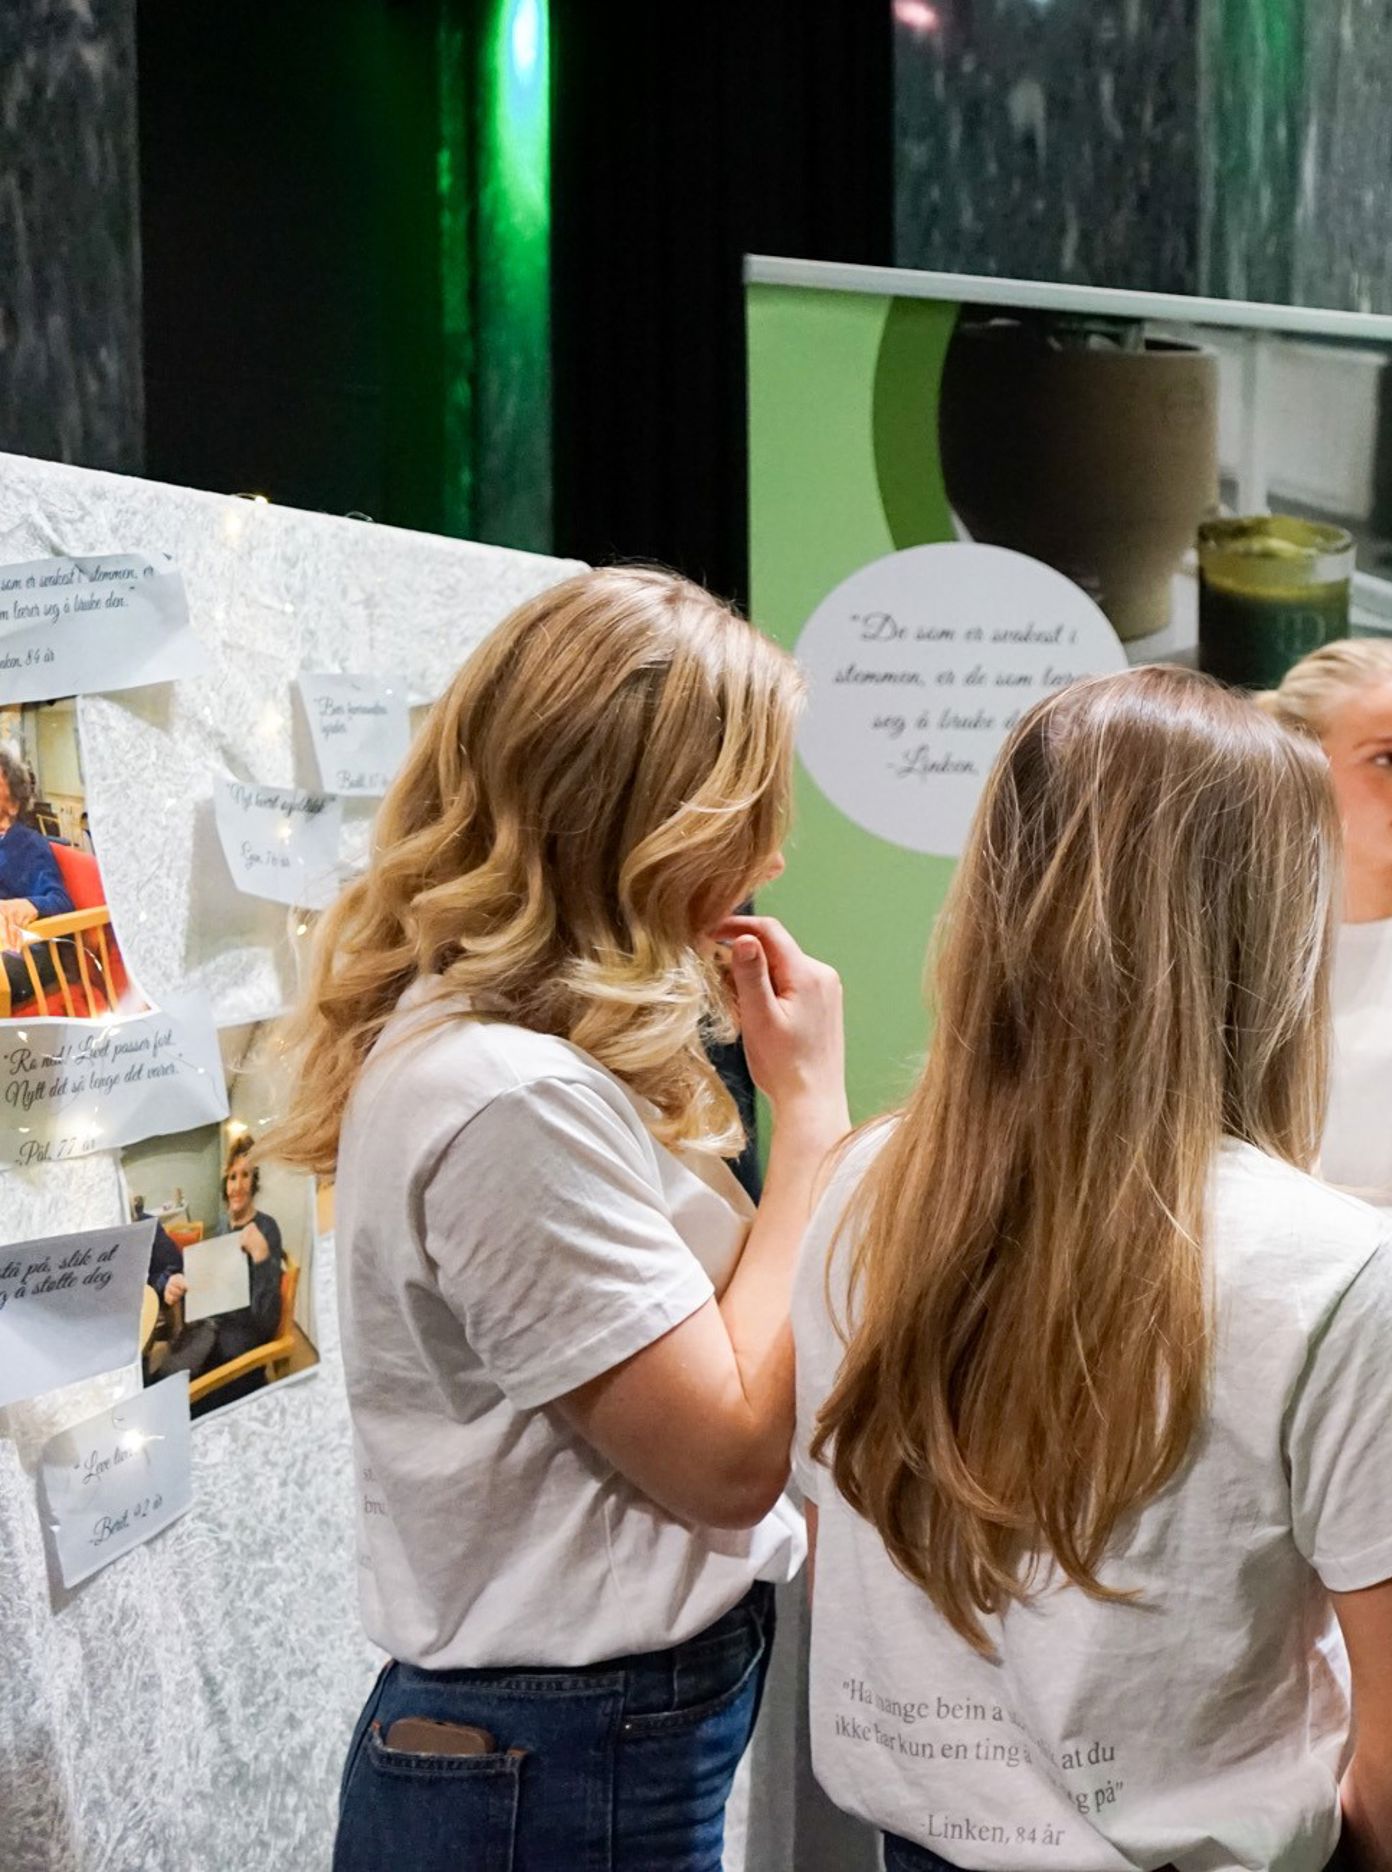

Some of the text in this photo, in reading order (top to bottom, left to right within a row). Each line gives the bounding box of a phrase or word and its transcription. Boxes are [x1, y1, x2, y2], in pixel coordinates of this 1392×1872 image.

[915, 625, 956, 643] som
[964, 626, 985, 642] er
[992, 620, 1066, 644] svakest
[832, 661, 926, 688] stemmen,
[935, 667, 956, 686] er
[964, 662, 988, 686] de
[996, 669, 1033, 687] som
[872, 714, 906, 739] seg
[936, 708, 997, 732] bruke
[49, 1076, 69, 1098] det
[124, 1063, 145, 1082] det
[58, 1247, 92, 1270] slik
[97, 1243, 120, 1263] at
[31, 1270, 79, 1296] støtte
[82, 1265, 113, 1292] deg
[834, 1713, 872, 1741] ikke
[898, 1732, 935, 1759] kun
[940, 1742, 969, 1760] en
[975, 1736, 1021, 1768] ting
[937, 1696, 986, 1721] bein
[1061, 1747, 1084, 1770] at
[1087, 1741, 1116, 1766] du
[1014, 1826, 1038, 1846] 84
[1041, 1823, 1067, 1847] år
